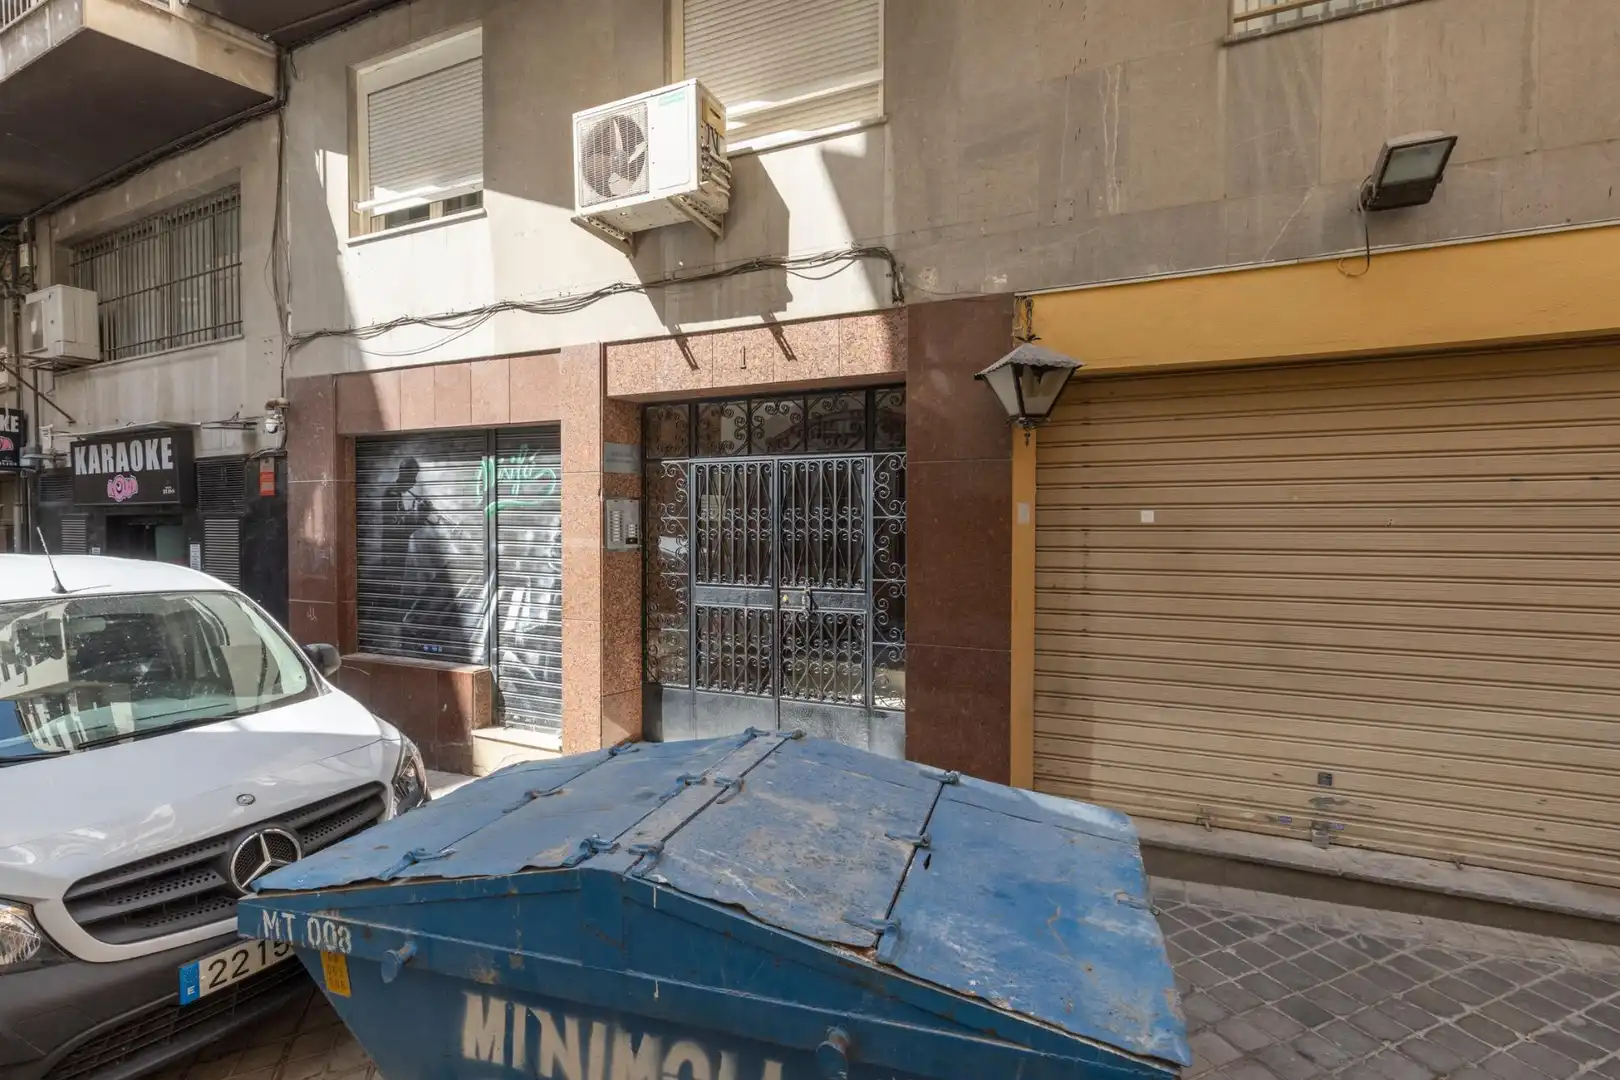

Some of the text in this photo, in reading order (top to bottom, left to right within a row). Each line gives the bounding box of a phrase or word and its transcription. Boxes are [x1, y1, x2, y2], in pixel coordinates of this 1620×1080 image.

[75, 437, 174, 475] KARAOKE
[262, 909, 296, 944] MT
[186, 985, 196, 997] E
